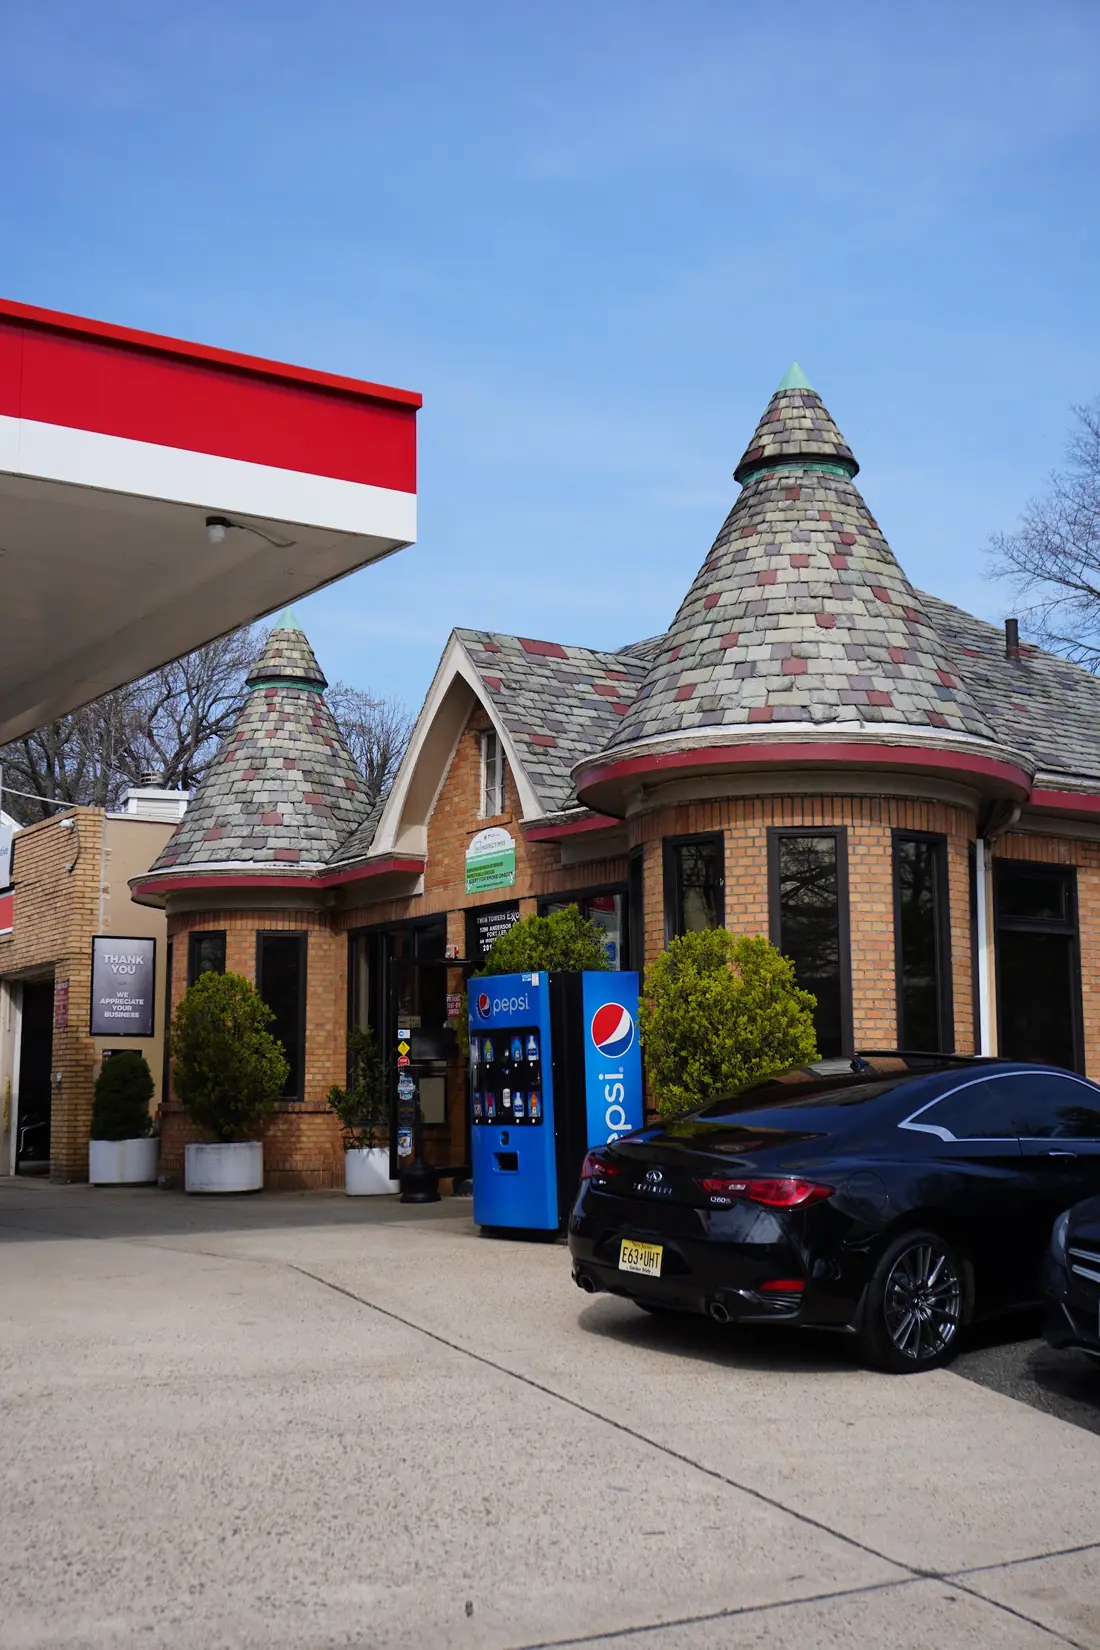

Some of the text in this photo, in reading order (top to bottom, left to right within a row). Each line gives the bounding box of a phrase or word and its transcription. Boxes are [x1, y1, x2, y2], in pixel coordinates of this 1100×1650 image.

[488, 914, 506, 922] TOWERS
[489, 923, 512, 932] ANDERSON
[103, 954, 144, 965] THANK
[111, 964, 136, 975] YOU
[111, 1004, 133, 1012] YOUR
[492, 992, 530, 1016] pepsi
[104, 1011, 140, 1019] BUSINESS
